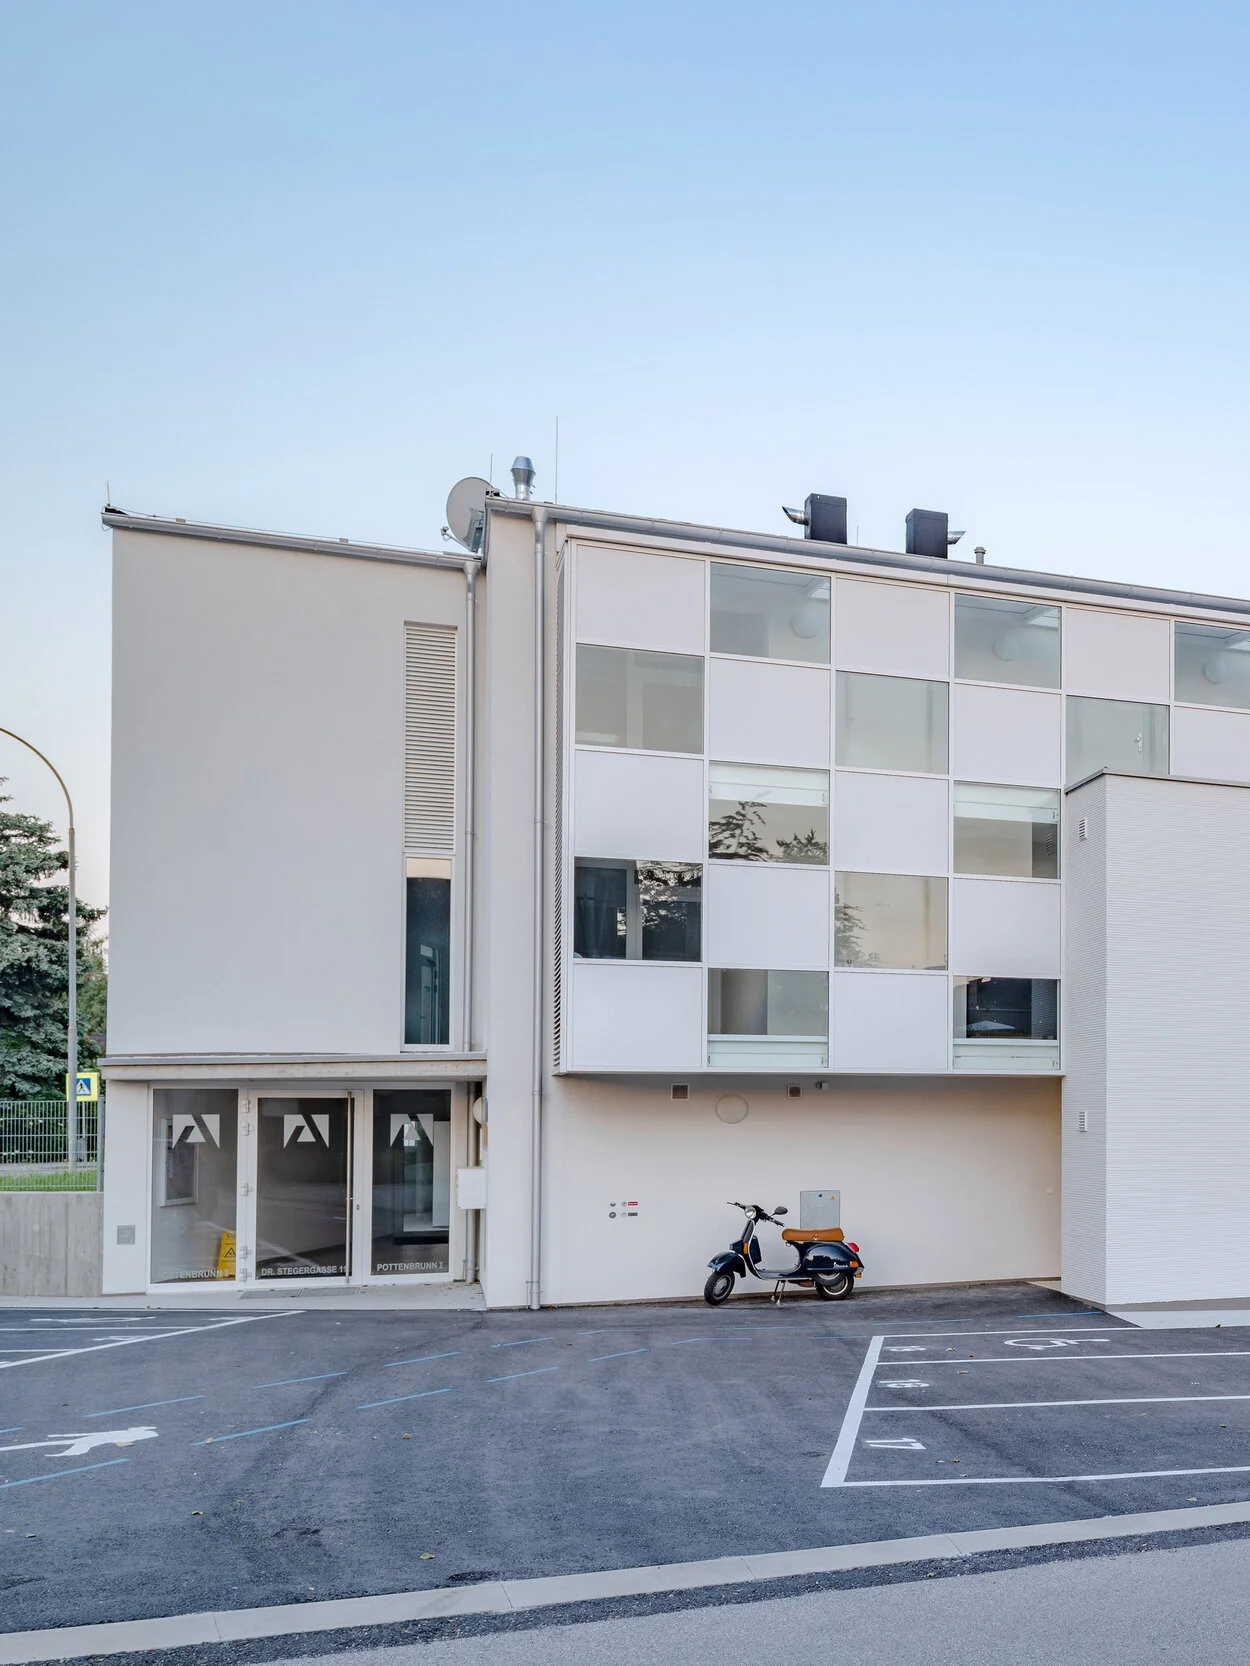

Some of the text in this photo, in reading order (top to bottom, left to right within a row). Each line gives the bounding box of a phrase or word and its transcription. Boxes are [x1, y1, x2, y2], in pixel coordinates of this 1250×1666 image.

[261, 1267, 276, 1276] DR.
[277, 1265, 337, 1276] STEGERGASSE
[376, 1262, 438, 1272] POTTENBRUNN
[864, 1437, 927, 1450] 17
